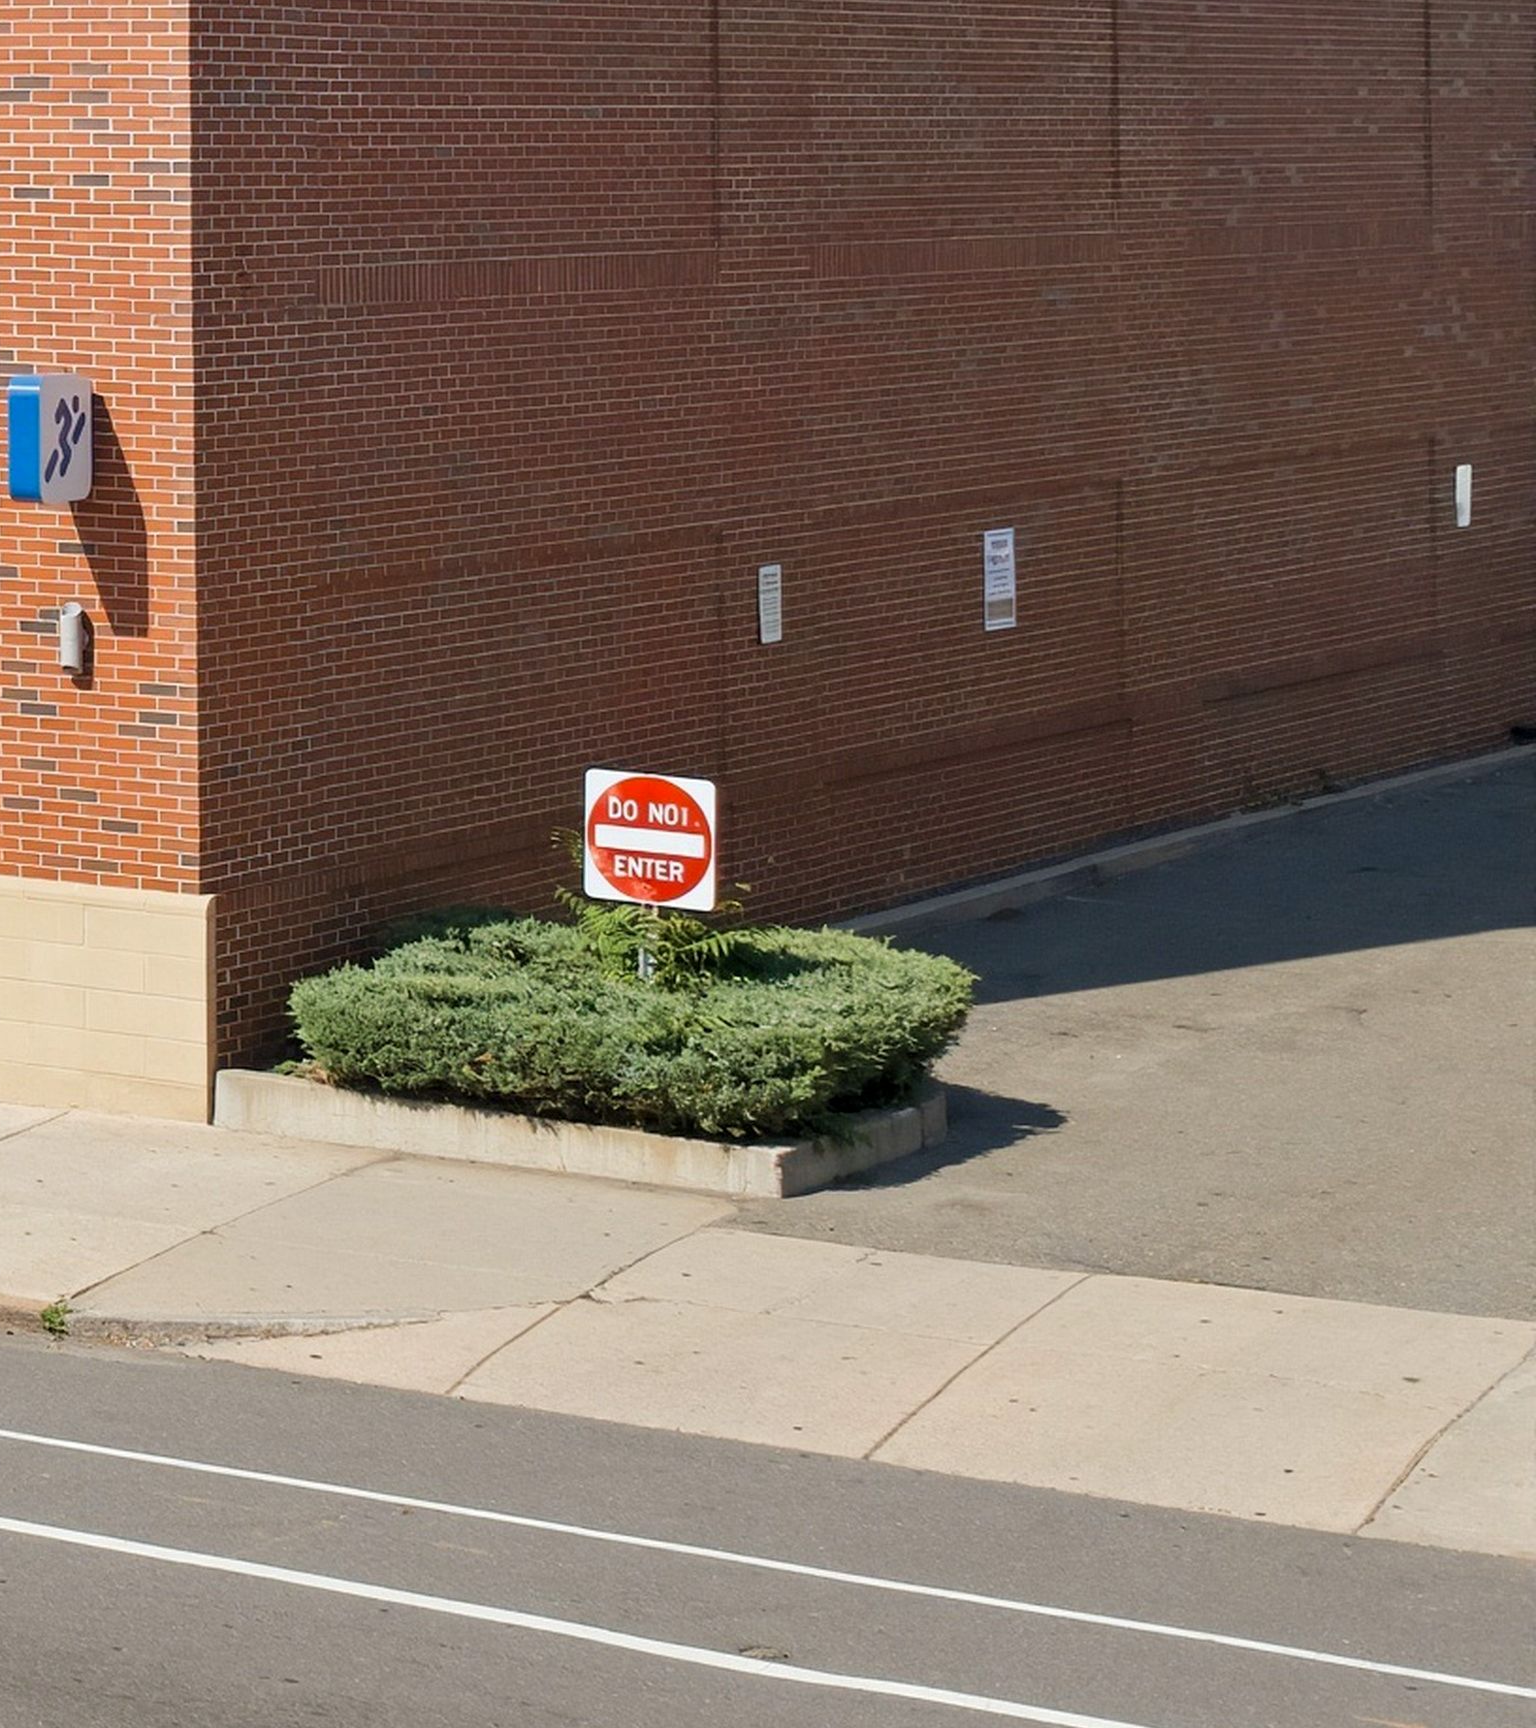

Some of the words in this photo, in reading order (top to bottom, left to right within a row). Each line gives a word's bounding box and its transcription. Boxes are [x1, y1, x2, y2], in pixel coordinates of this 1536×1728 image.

[608, 796, 638, 821] DO
[648, 802, 689, 827] NOT
[614, 854, 685, 884] ENTER
